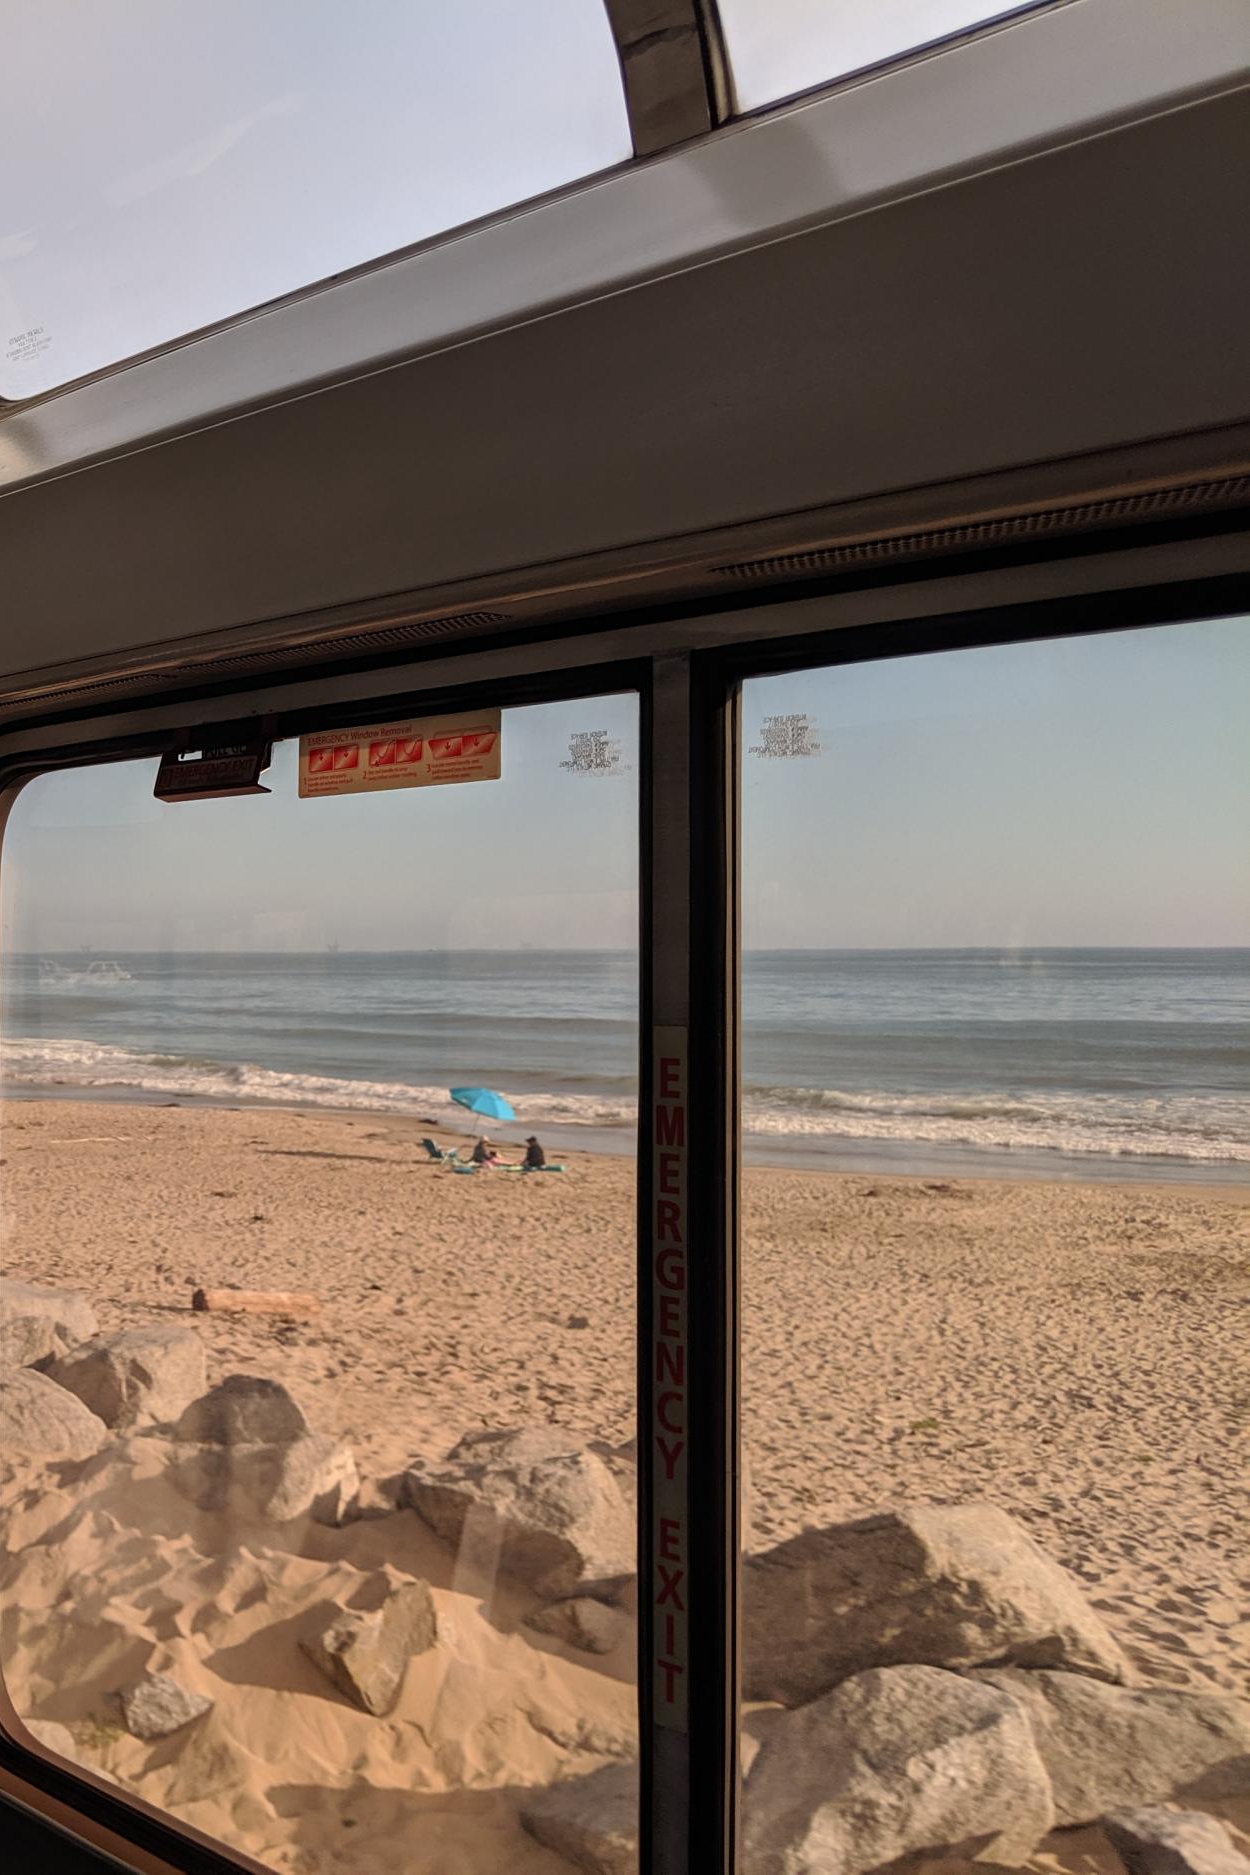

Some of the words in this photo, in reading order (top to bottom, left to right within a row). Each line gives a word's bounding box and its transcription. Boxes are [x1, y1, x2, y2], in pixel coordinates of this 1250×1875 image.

[308, 732, 350, 746] EMERGENCY
[350, 729, 379, 740] Window
[380, 725, 413, 737] Removal
[655, 1057, 685, 1480] EMERGENCY
[655, 1518, 685, 1704] EXIT
